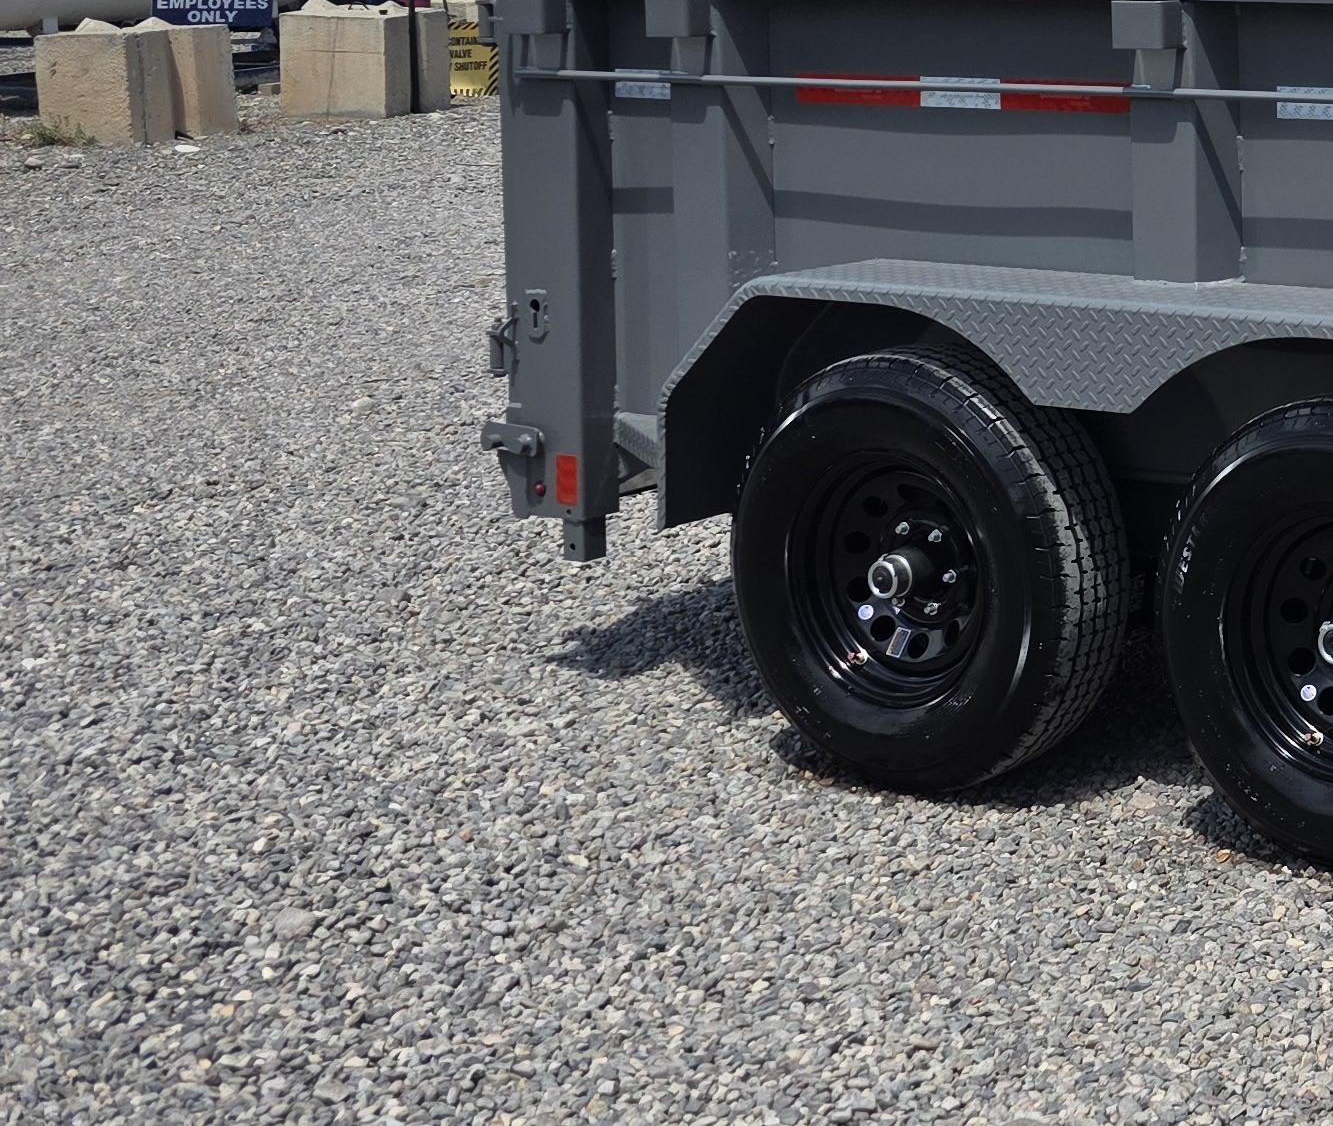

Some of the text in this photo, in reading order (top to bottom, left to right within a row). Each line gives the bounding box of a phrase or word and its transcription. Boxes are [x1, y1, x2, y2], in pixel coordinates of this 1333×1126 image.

[187, 11, 238, 23] ONLY
[450, 49, 472, 58] VALVE
[454, 61, 487, 71] SHUTOFF
